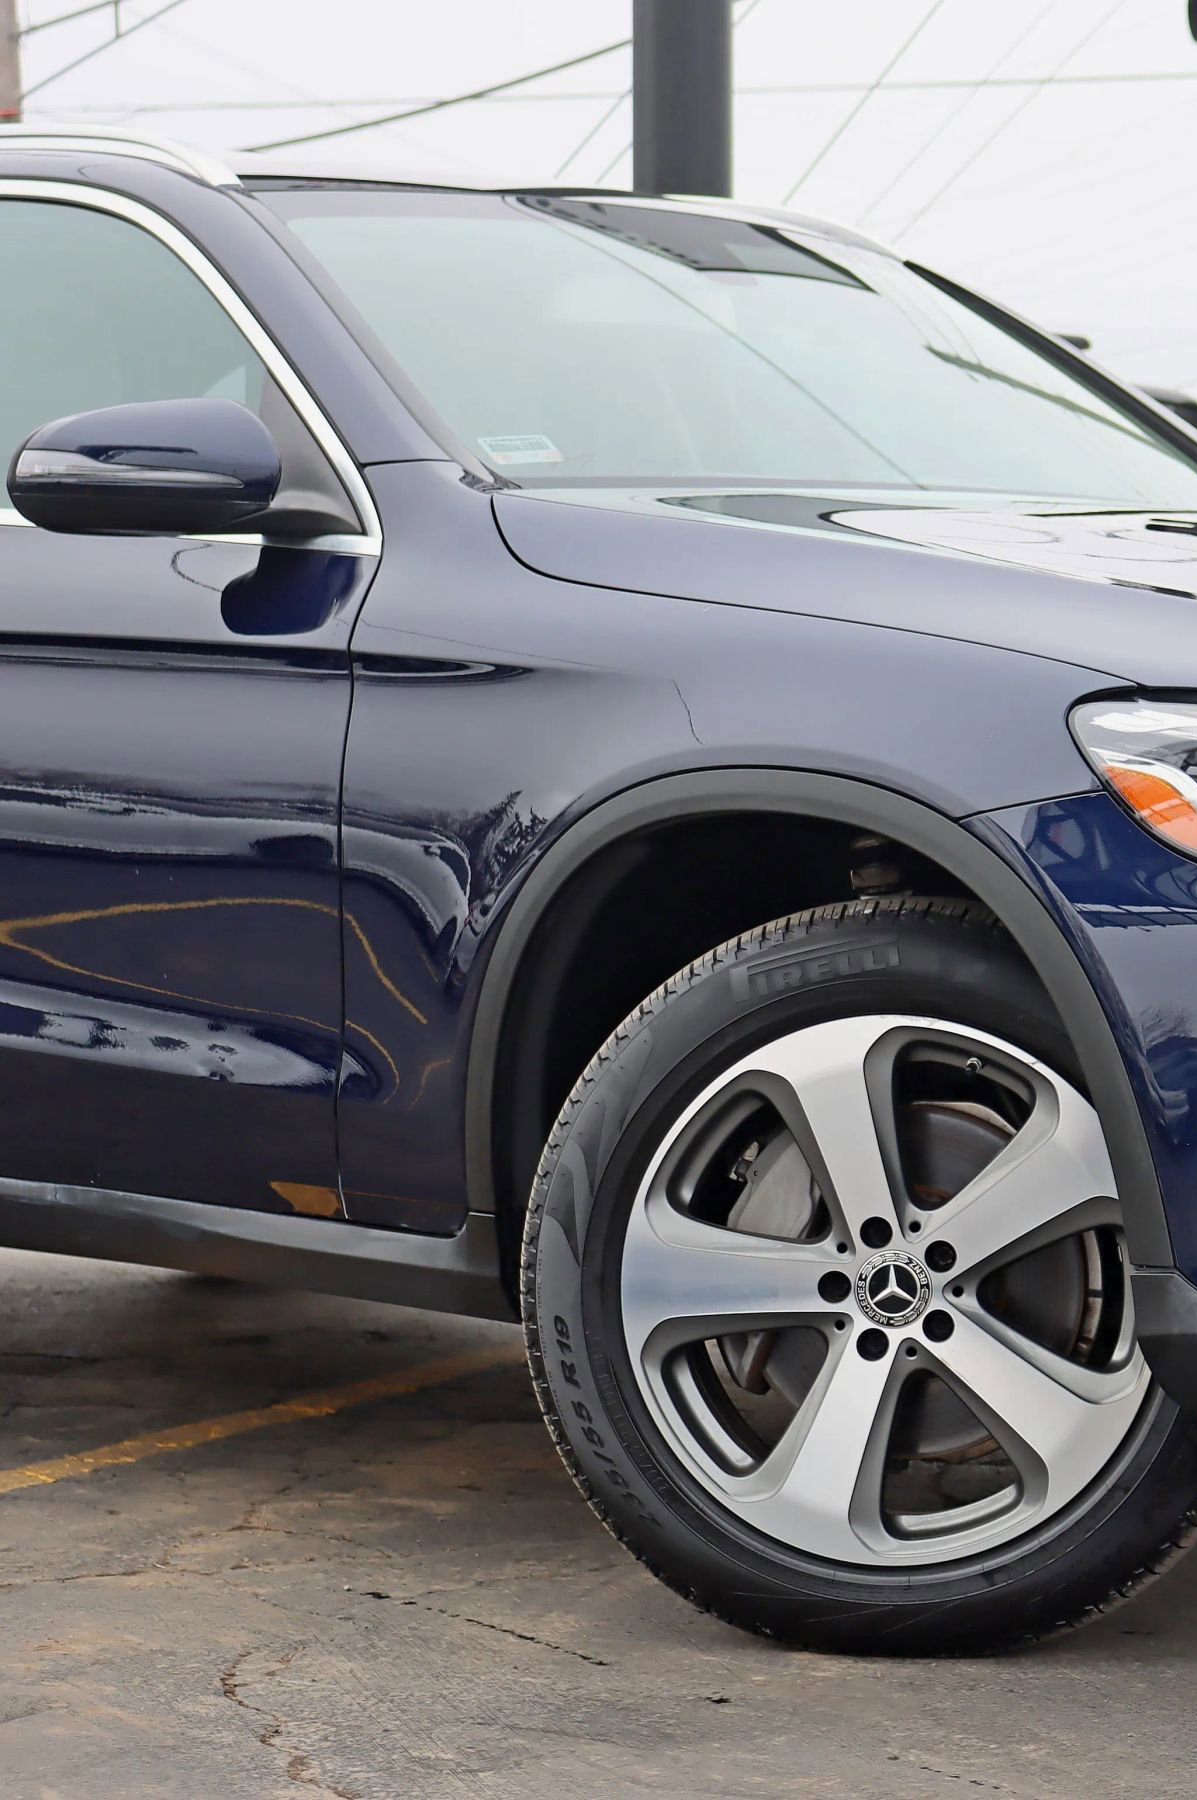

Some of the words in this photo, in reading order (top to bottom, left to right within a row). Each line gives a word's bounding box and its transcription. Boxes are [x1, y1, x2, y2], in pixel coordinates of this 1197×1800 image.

[730, 934, 902, 1003] PIRELLI
[909, 1261, 929, 1285] BENZ
[857, 1280, 889, 1325] MERCEDES
